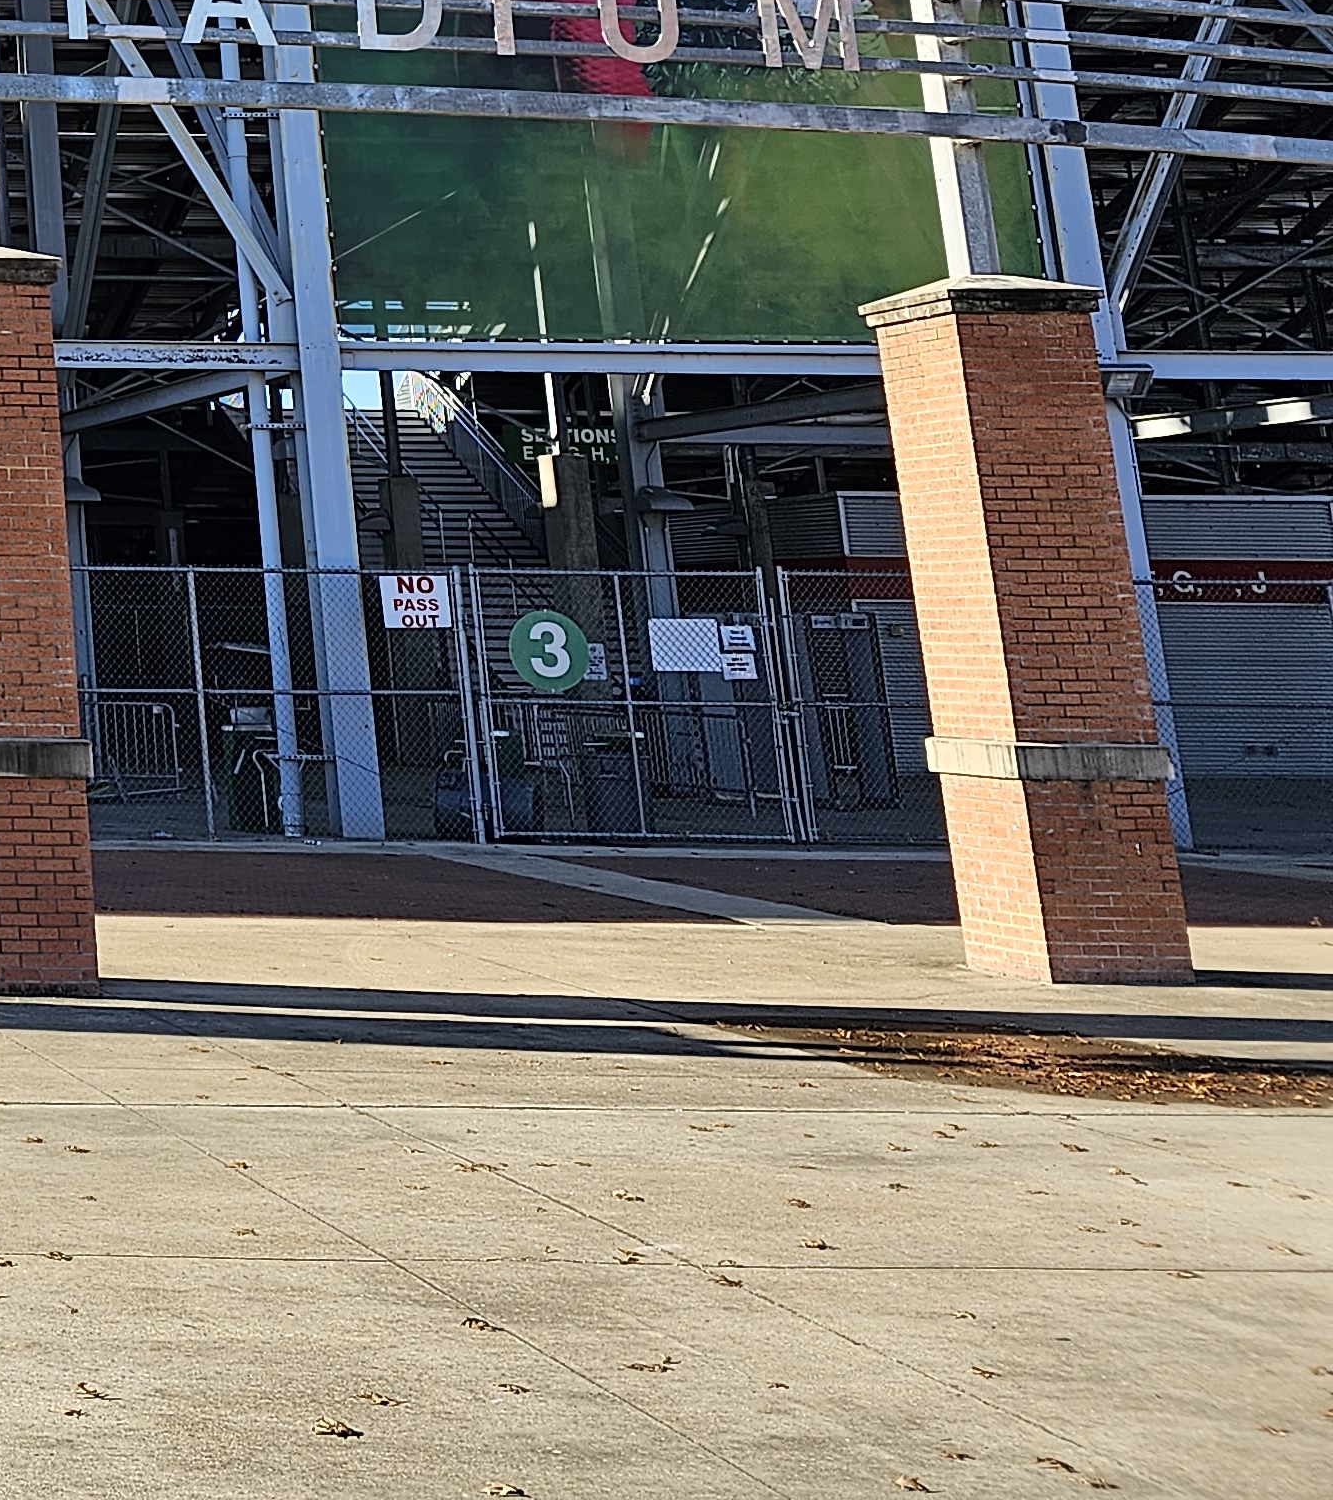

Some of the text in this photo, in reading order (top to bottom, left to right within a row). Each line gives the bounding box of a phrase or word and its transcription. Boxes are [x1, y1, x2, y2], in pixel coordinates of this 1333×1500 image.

[396, 576, 435, 594] NO
[393, 598, 440, 612] PASS
[401, 614, 440, 628] OUT
[529, 621, 571, 678] 3
